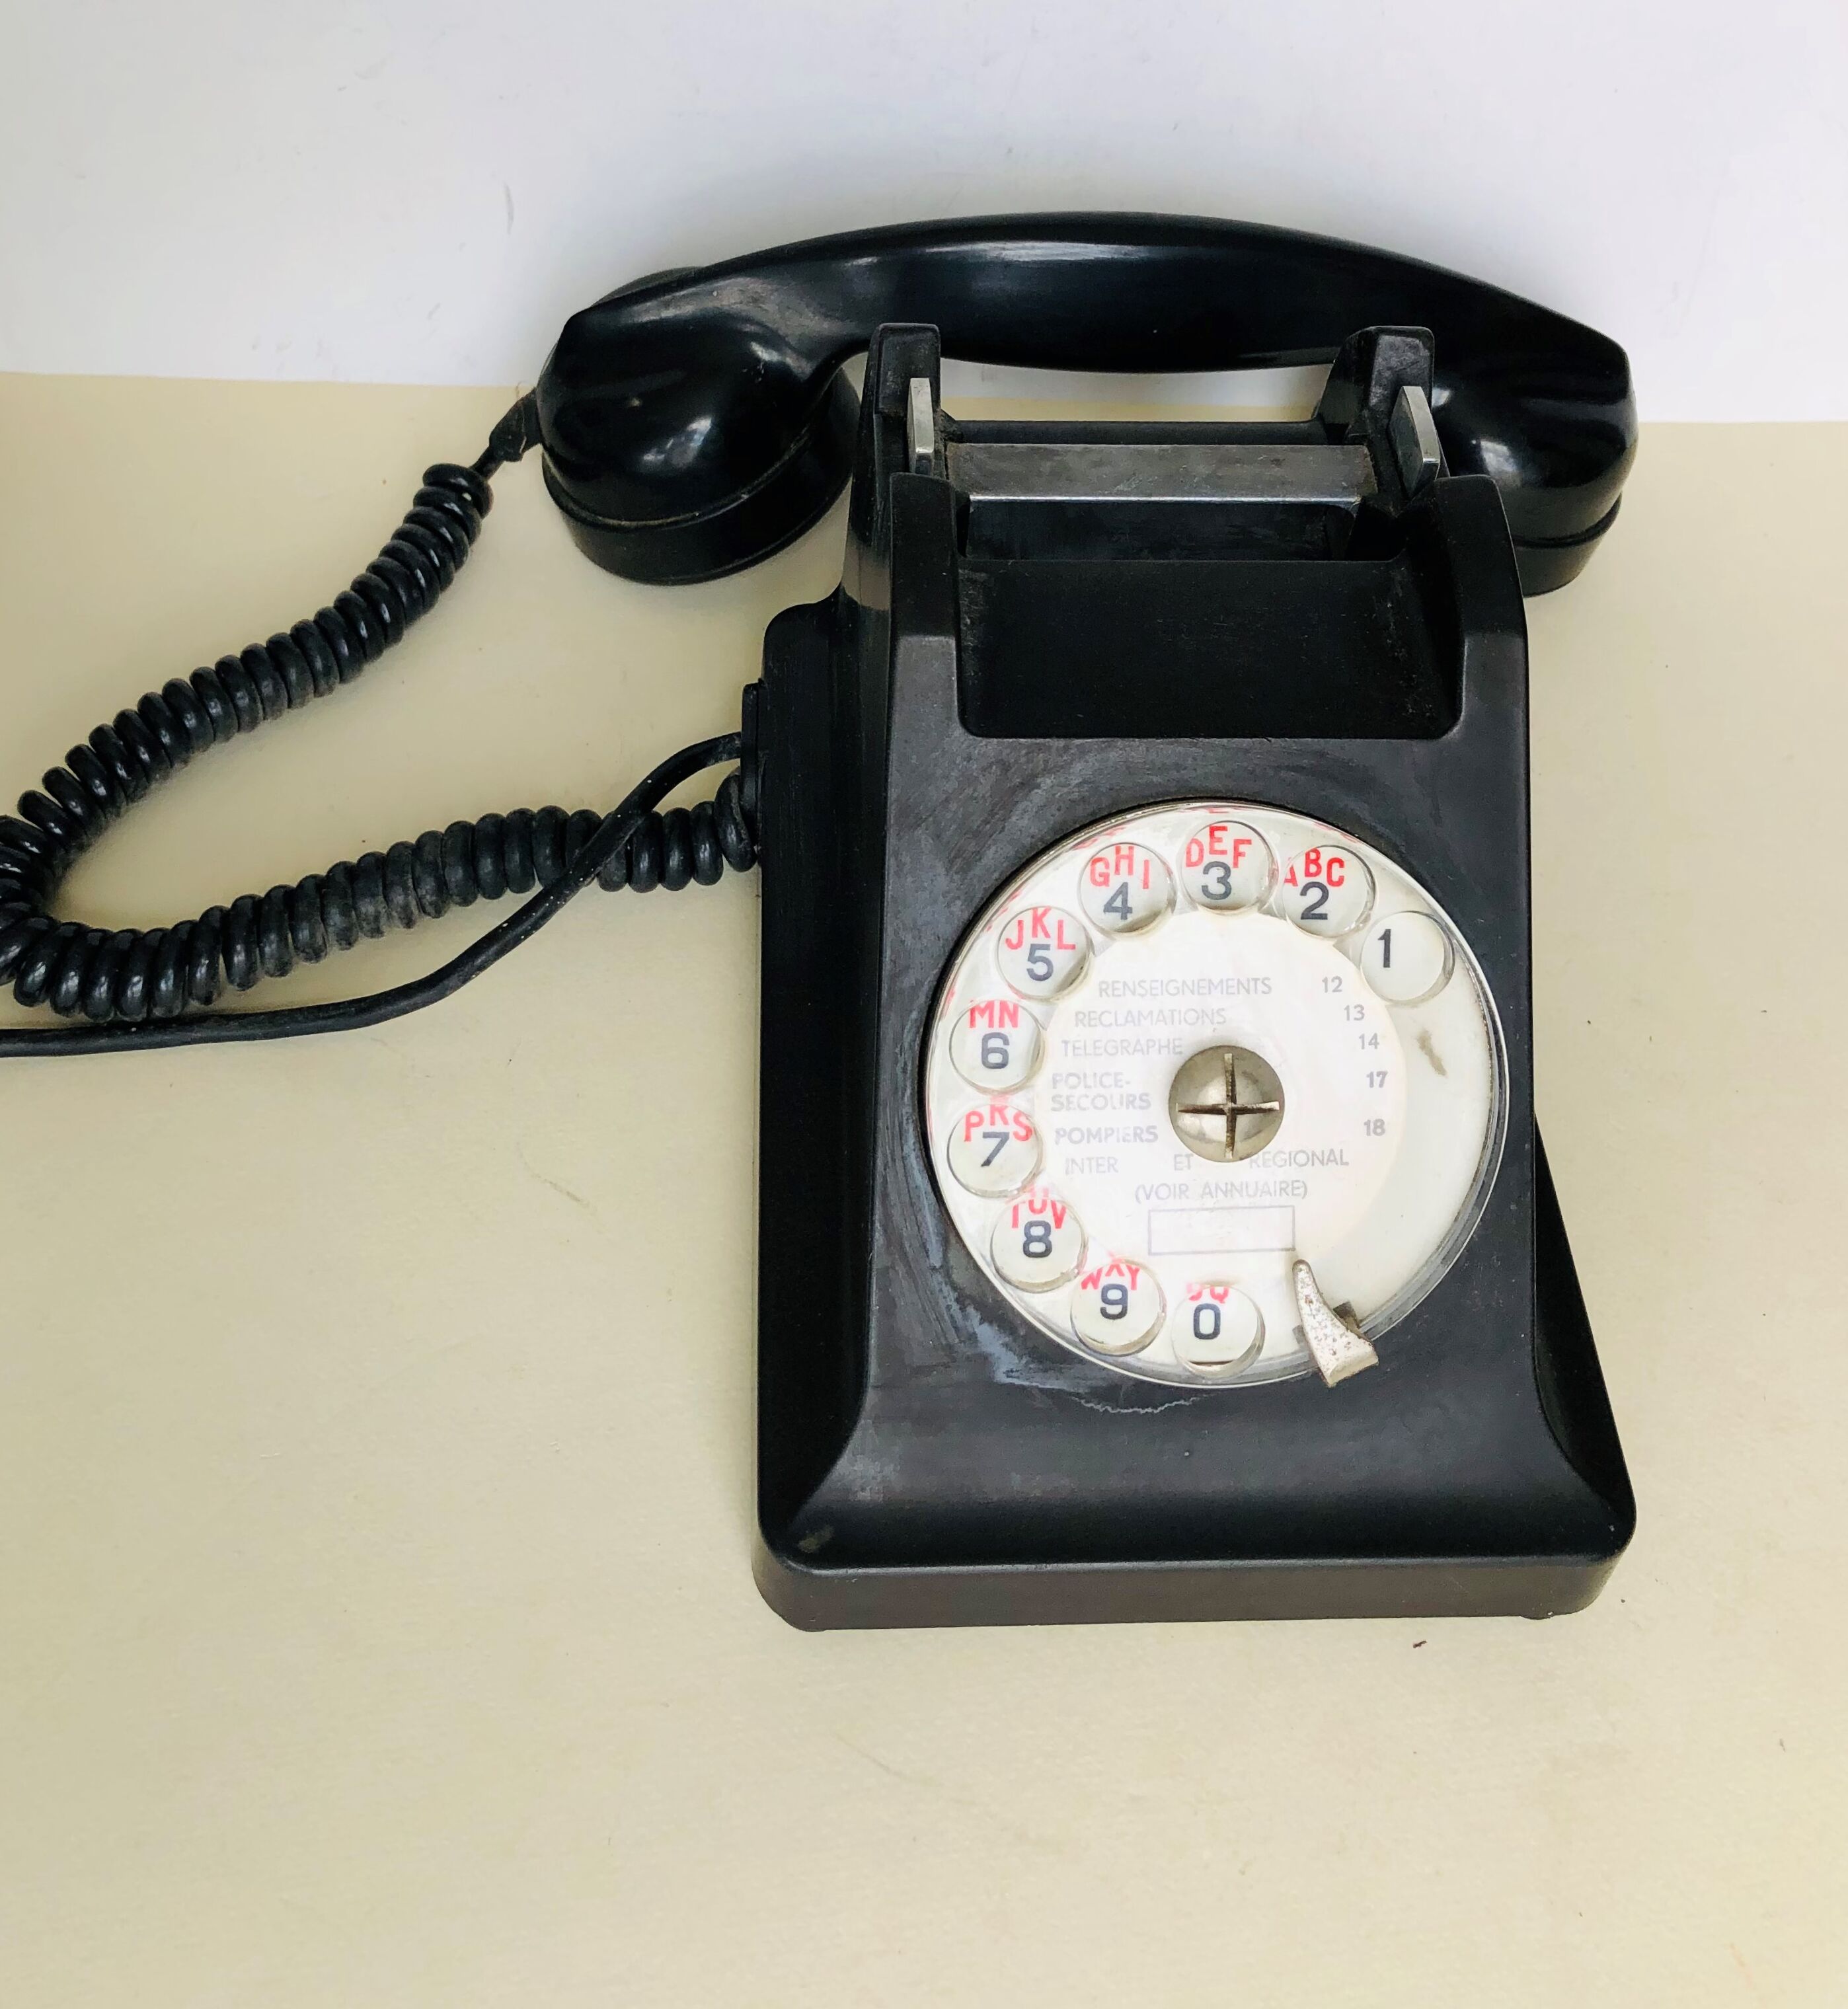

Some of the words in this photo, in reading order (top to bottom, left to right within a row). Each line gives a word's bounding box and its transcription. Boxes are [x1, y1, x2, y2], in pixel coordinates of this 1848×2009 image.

[1185, 825, 1252, 869] DEF
[1089, 845, 1150, 890] GHI
[1201, 861, 1232, 900] 3
[1284, 847, 1345, 887] ABC
[1103, 882, 1133, 920] 4
[1299, 881, 1330, 921] 2
[1005, 906, 1076, 950] JKL
[1026, 943, 1054, 981] 5
[1377, 929, 1391, 968] 1
[1098, 977, 1272, 999] RENSEIGNEMENTS
[1322, 976, 1342, 993] 12
[969, 1000, 1019, 1028] MN
[1074, 1007, 1227, 1028] RECLAMATIONS
[1344, 1004, 1365, 1021] 13
[981, 1032, 1009, 1069] 6
[1061, 1038, 1183, 1057] TELEGRAPHE
[1358, 1032, 1380, 1050] 14
[1366, 1070, 1388, 1088] 17
[1050, 1092, 1151, 1112] SECOURS
[964, 1104, 1033, 1142] PRS
[1054, 1125, 1159, 1145] POMPIERS
[1364, 1119, 1386, 1136] 18
[980, 1132, 1010, 1167] 7
[1065, 1156, 1119, 1175] INTER
[1173, 1153, 1194, 1171] ET
[1249, 1149, 1349, 1168] REGIONAL
[1134, 1182, 1190, 1205] (VOIR
[1201, 1180, 1308, 1200] ANNUAIRE)
[1022, 1220, 1052, 1258] 8
[1100, 1283, 1128, 1320] 9
[1193, 1303, 1221, 1340] 0
